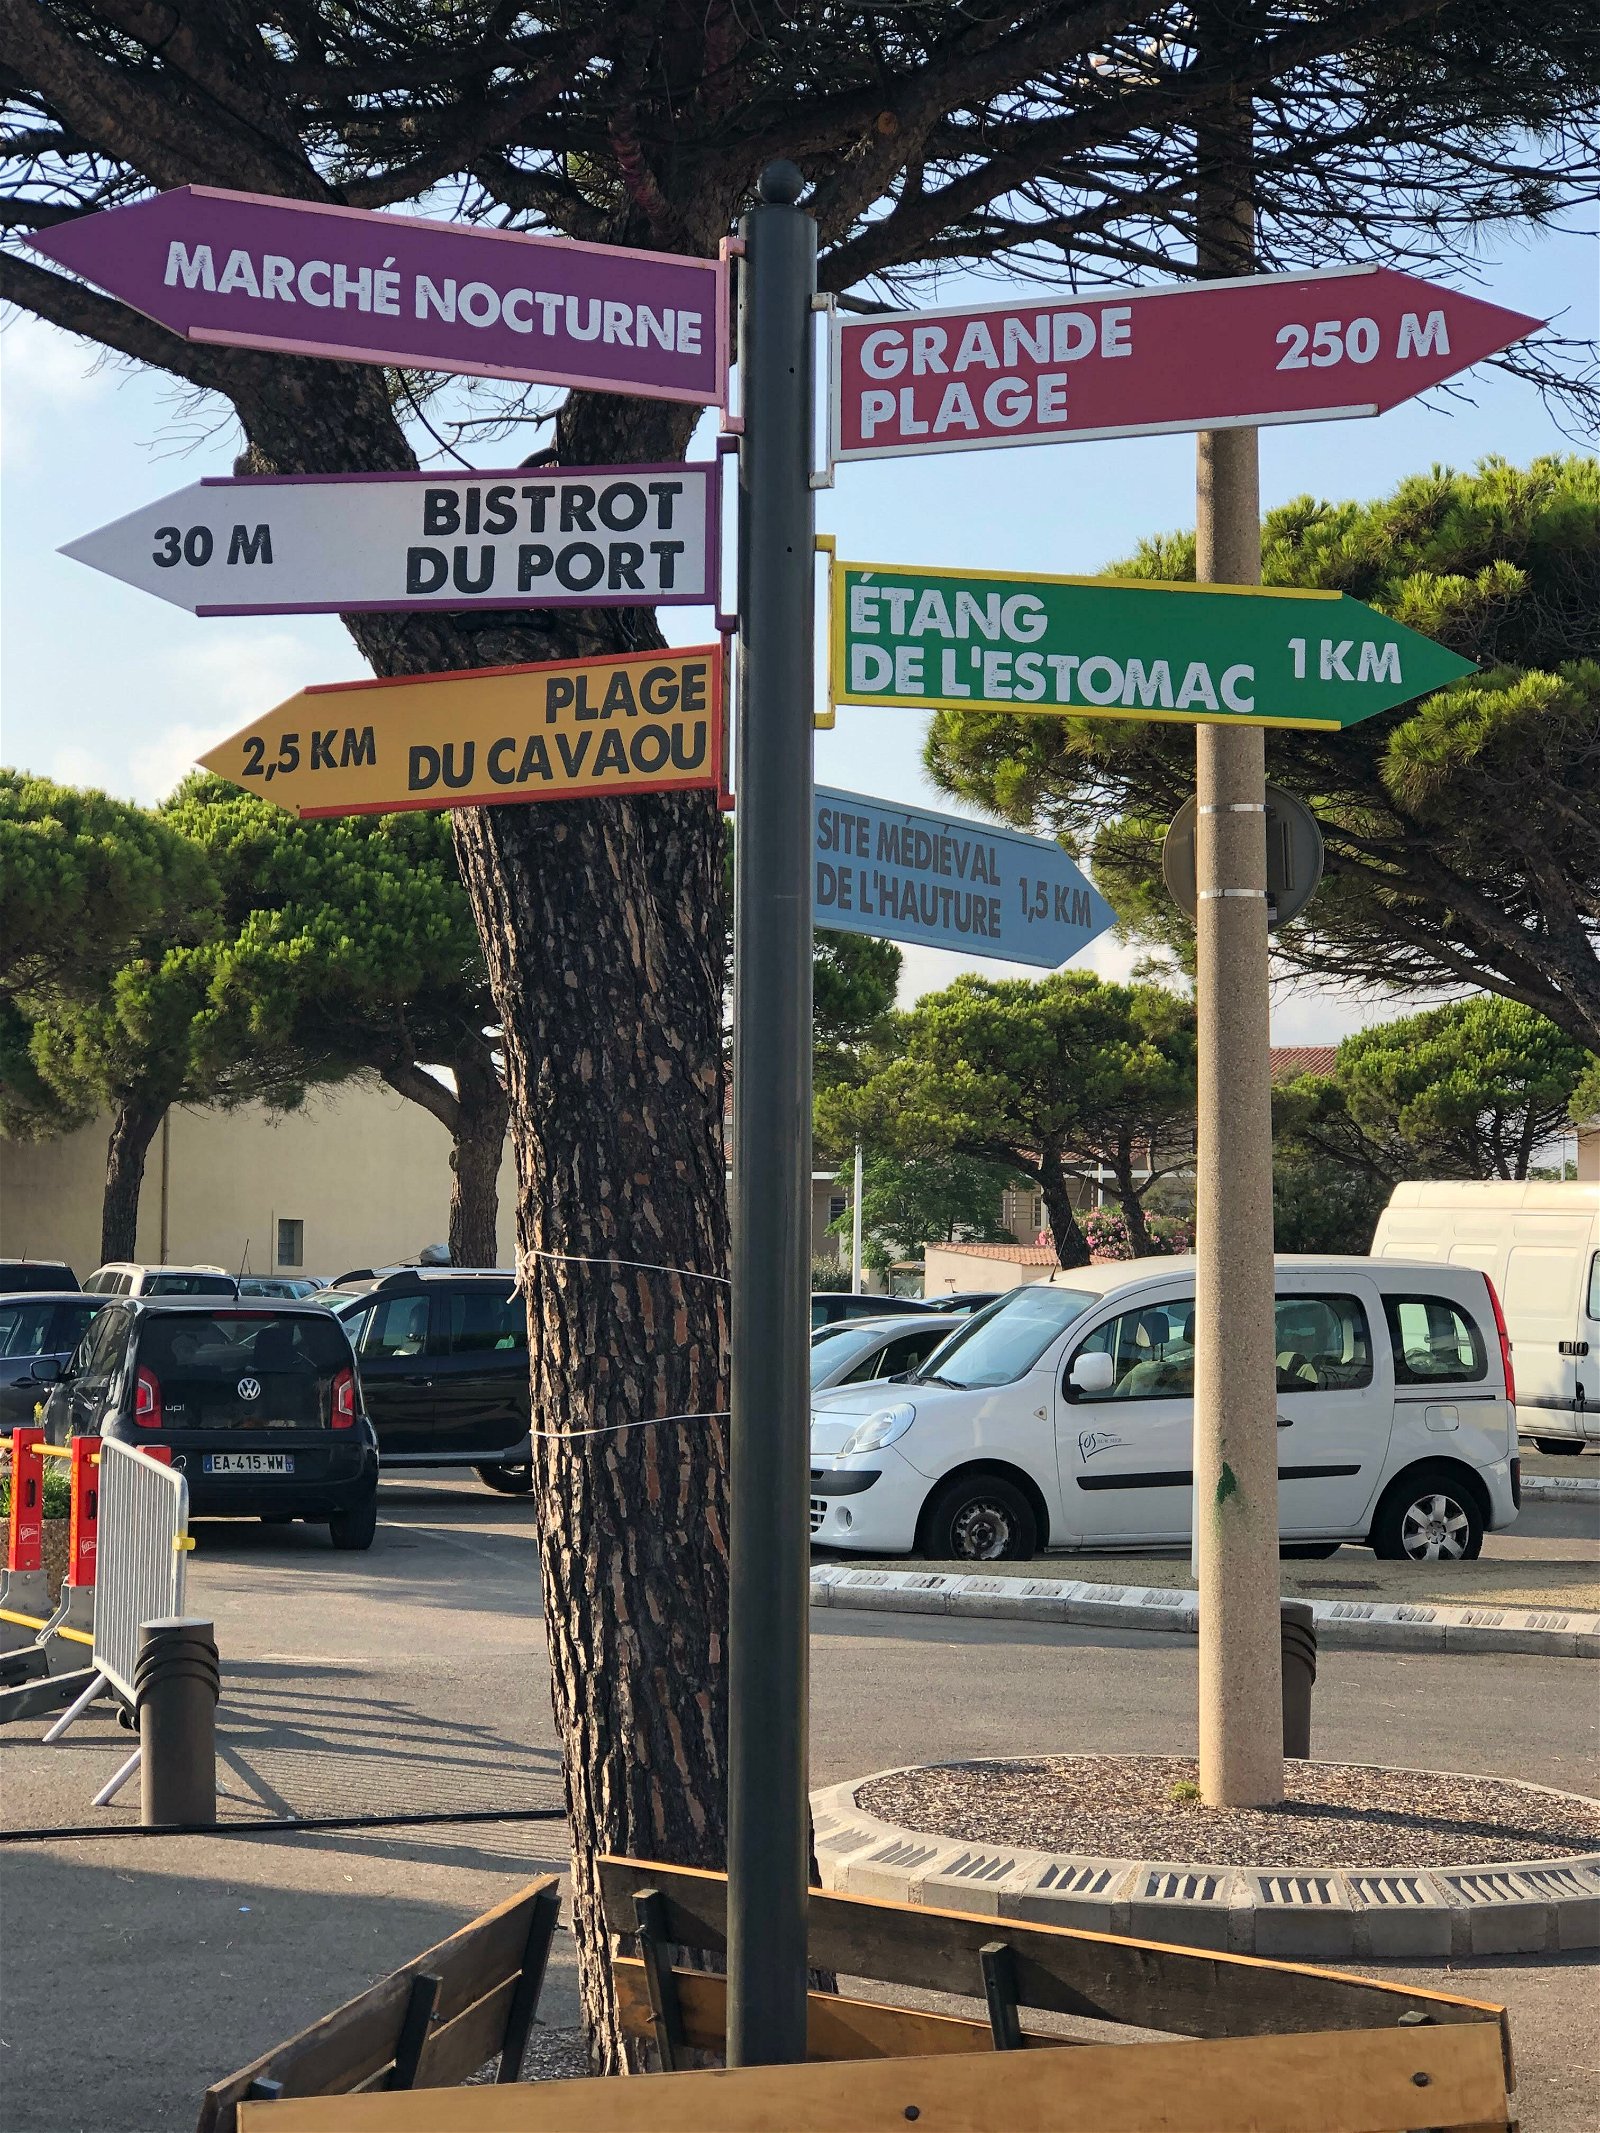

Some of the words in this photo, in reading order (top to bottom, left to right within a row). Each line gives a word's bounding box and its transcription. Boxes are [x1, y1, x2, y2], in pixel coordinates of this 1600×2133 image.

[164, 241, 401, 316] MARCHÉ
[415, 275, 702, 355] NOCTURNE
[860, 307, 1133, 380] GRANDE
[1276, 318, 1380, 370] 250
[1396, 311, 1451, 358] M
[861, 373, 1068, 439] PLAGE
[423, 482, 683, 536] BISTROT
[153, 526, 213, 567] 30
[227, 524, 274, 565] M
[406, 545, 496, 594] DU
[518, 541, 684, 592] PORT
[850, 572, 1048, 643] ÉTANG
[850, 643, 925, 696] DE
[941, 647, 1255, 712] L'ESTOMAC
[1288, 638, 1306, 679] 1
[1320, 639, 1403, 684] KM
[546, 664, 706, 724] PLAGE
[242, 734, 300, 781] 2,5
[311, 726, 377, 770] KM
[408, 741, 476, 790] DU
[487, 720, 706, 784] CAVAOU
[817, 808, 869, 858] SITE
[877, 815, 1000, 887] MÉDIÉVAL
[817, 861, 851, 910] DE
[860, 870, 1000, 938] L'HAUTURE
[1019, 877, 1048, 923] 1,5
[1055, 884, 1092, 928] KM
[213, 1456, 283, 1470] EA-415-WW
